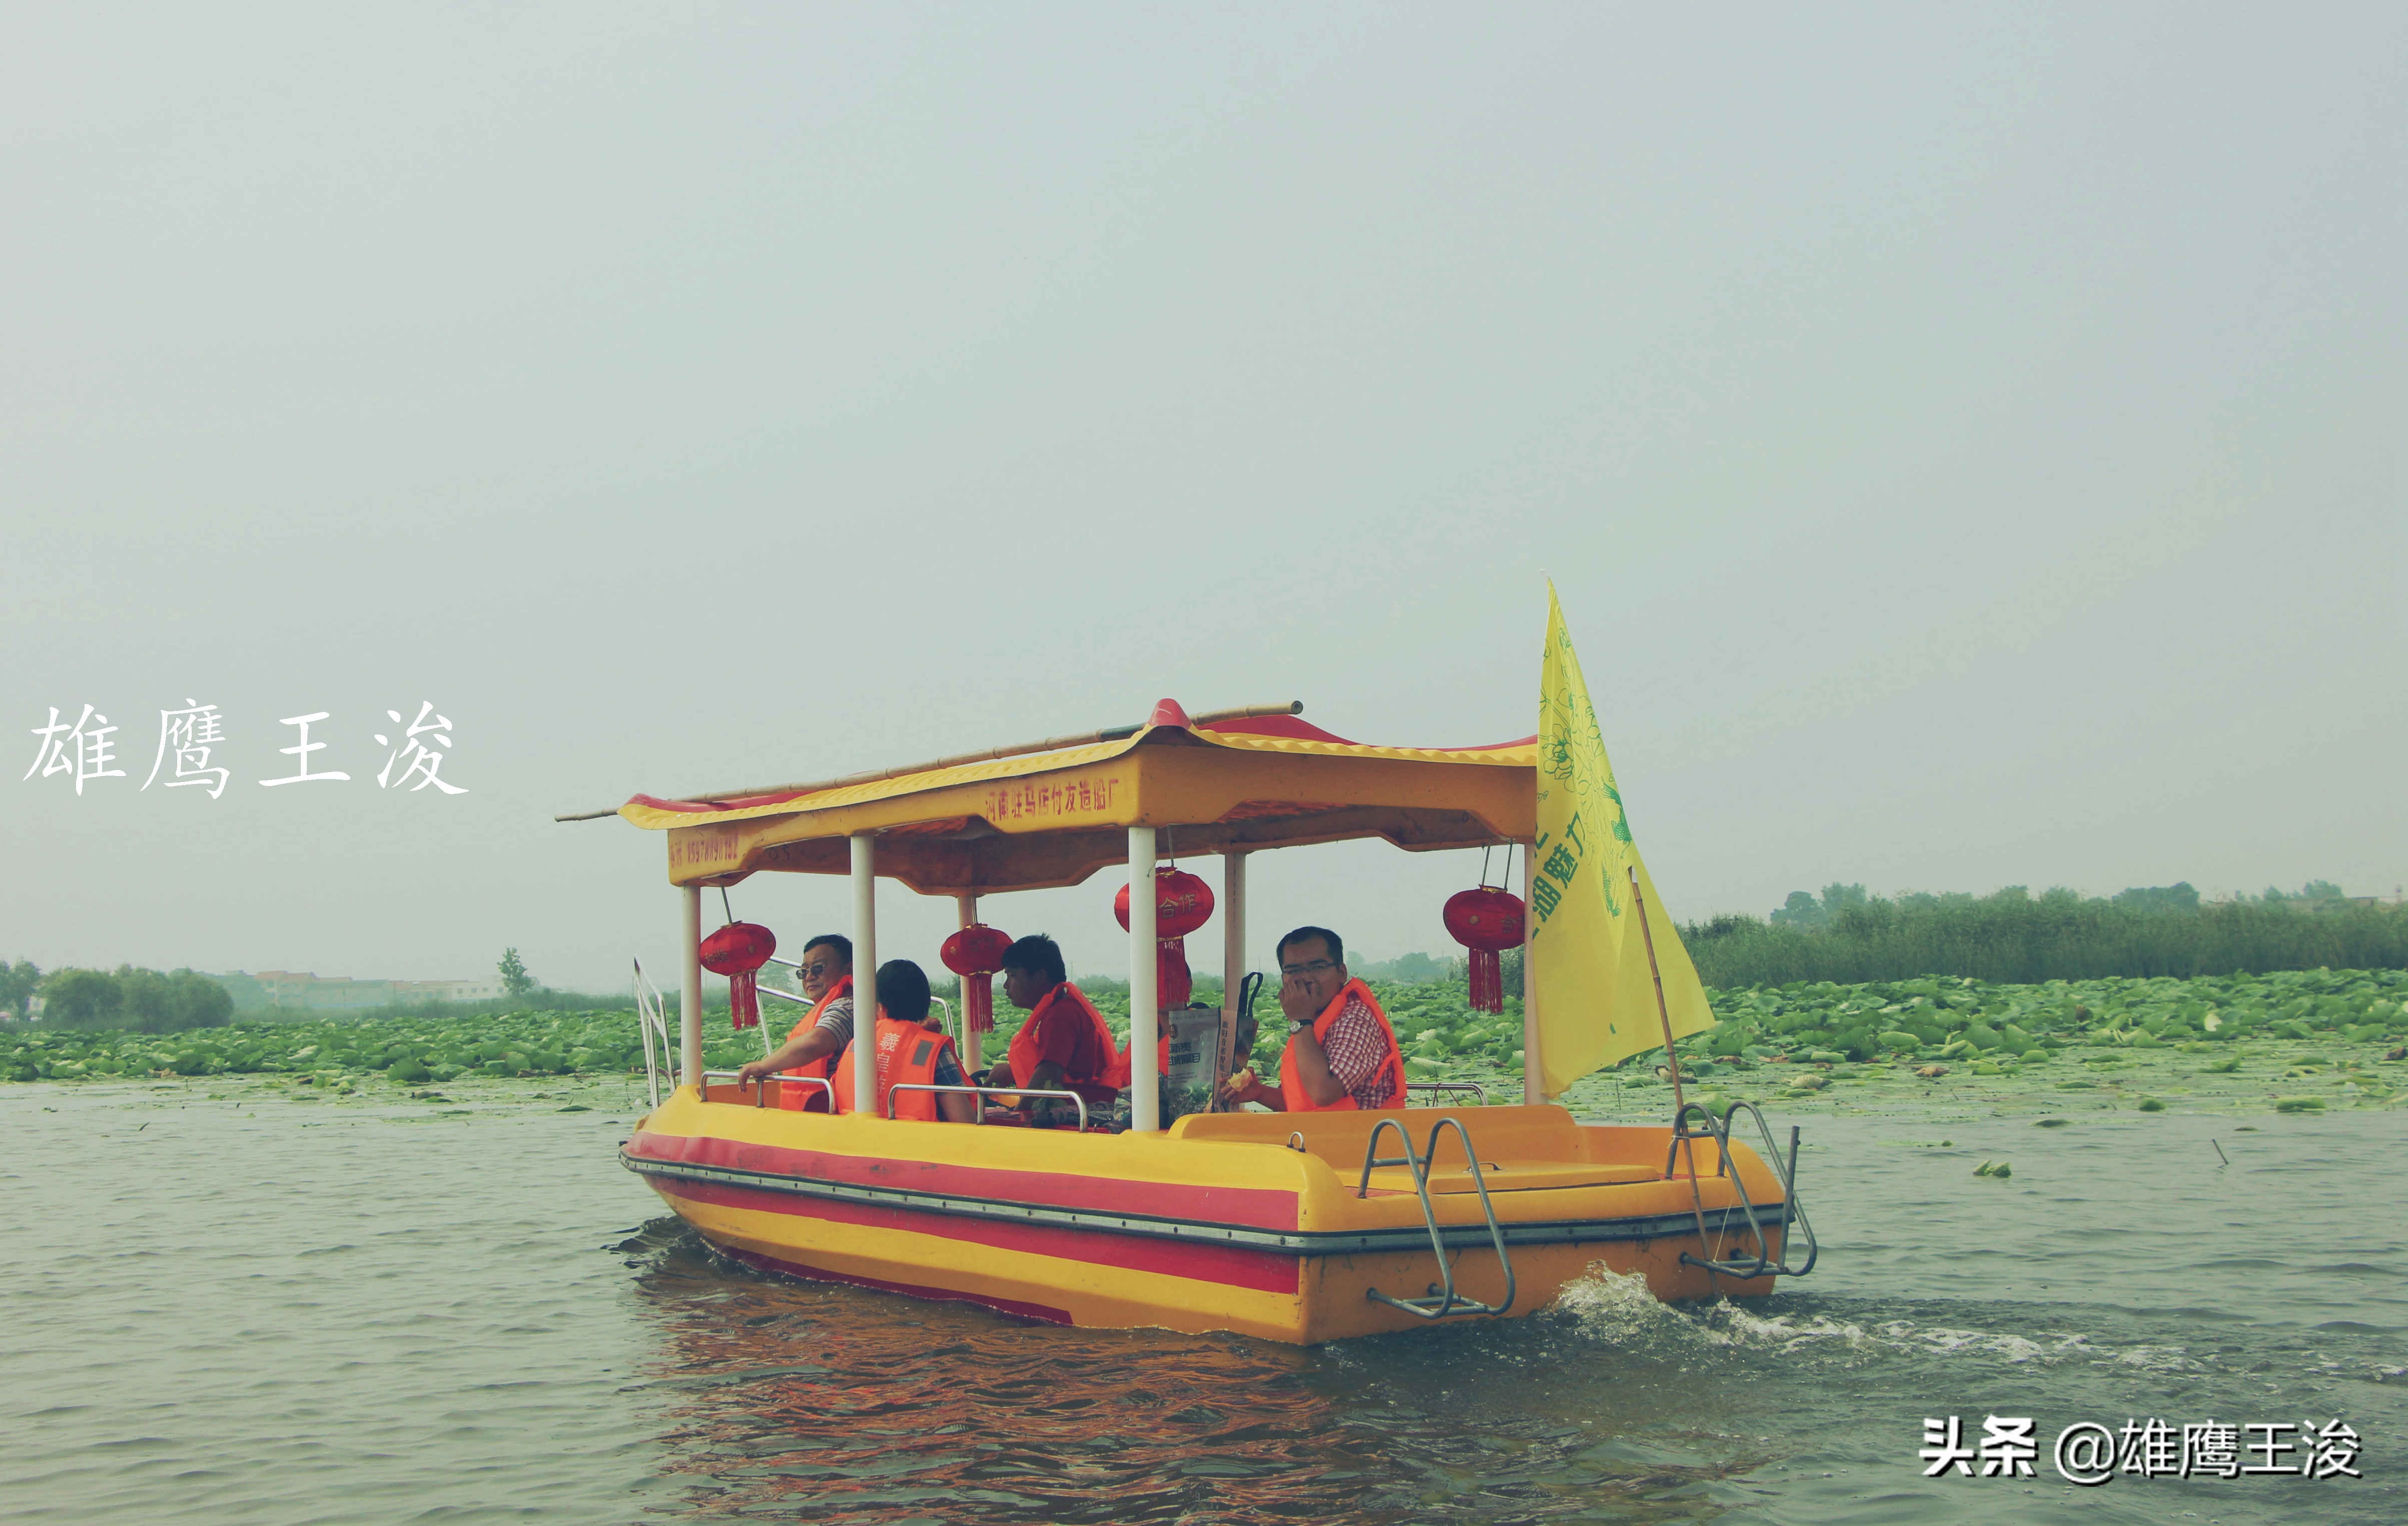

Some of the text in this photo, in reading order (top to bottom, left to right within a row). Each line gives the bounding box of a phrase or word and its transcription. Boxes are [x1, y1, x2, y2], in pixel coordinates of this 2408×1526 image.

[1158, 893, 1197, 918] 合作
[1533, 810, 1586, 940] 湖魅力
